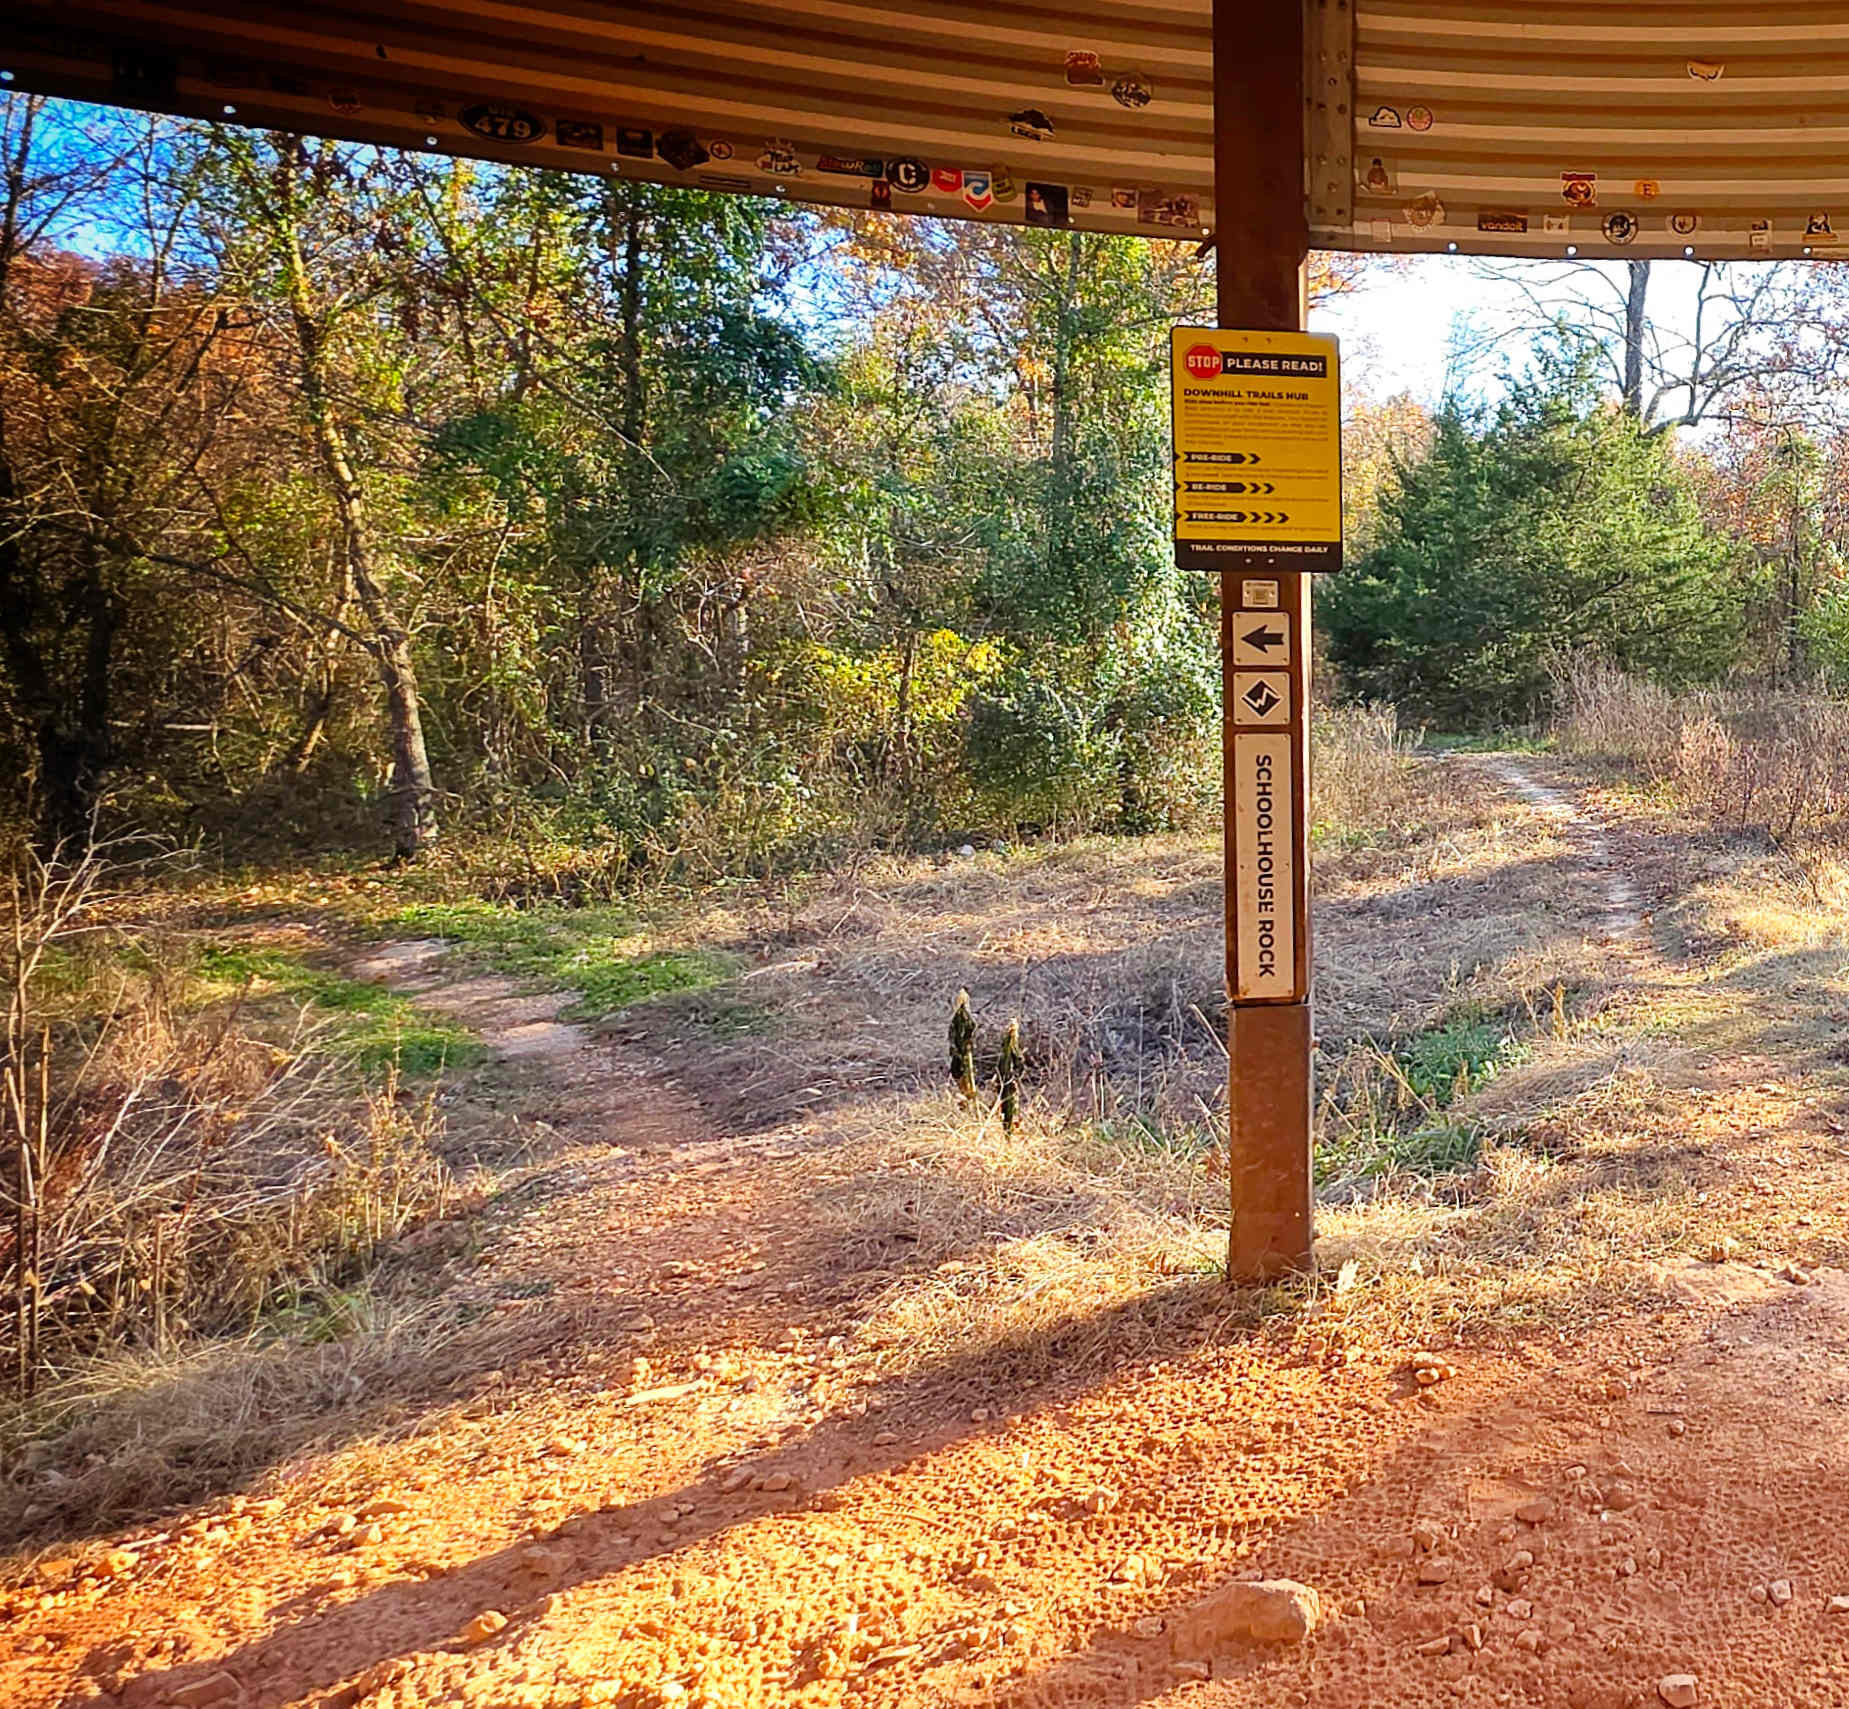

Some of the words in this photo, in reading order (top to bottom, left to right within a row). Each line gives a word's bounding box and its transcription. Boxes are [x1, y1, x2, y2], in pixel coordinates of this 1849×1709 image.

[473, 115, 531, 139] 479
[1187, 355, 1220, 369] STOP
[1227, 358, 1279, 370] PLEASE
[1282, 360, 1323, 372] READ!
[1184, 388, 1243, 398] DOWNHILL
[1247, 390, 1284, 400] TRAILS
[1286, 392, 1309, 401] HUB
[1269, 545, 1303, 553] CHANGE
[1256, 754, 1274, 913] SCHOOLHOUSE
[1258, 919, 1275, 977] ROCK
